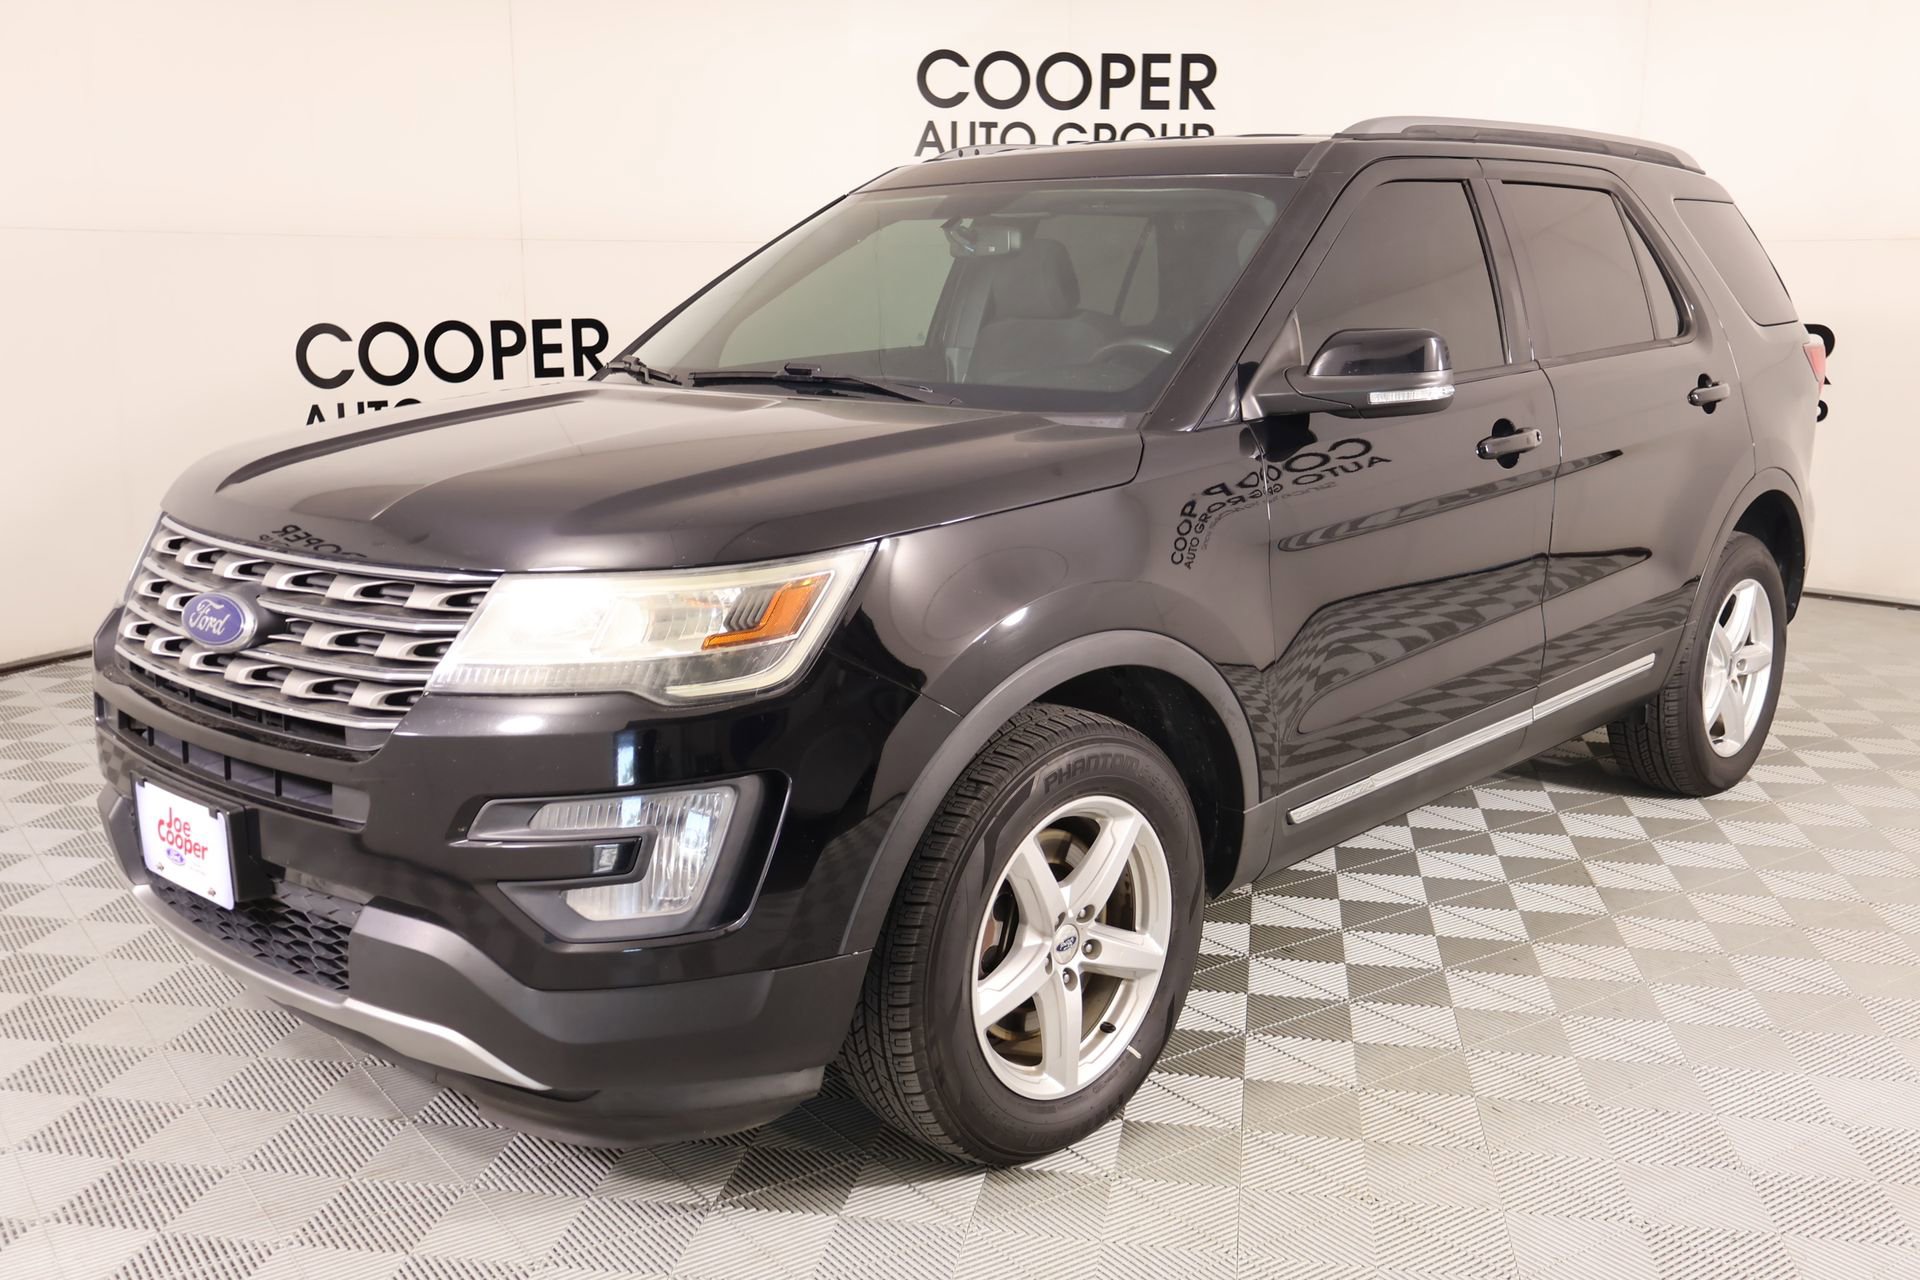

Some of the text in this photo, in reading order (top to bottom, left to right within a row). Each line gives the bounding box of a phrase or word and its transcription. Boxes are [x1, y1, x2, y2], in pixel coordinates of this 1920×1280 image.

[916, 48, 1217, 111] COOPER
[913, 120, 1036, 157] AUTO
[295, 317, 609, 390] COOPER
[189, 598, 231, 636] Ford
[157, 818, 209, 861] Cooper
[166, 806, 192, 838] Joe
